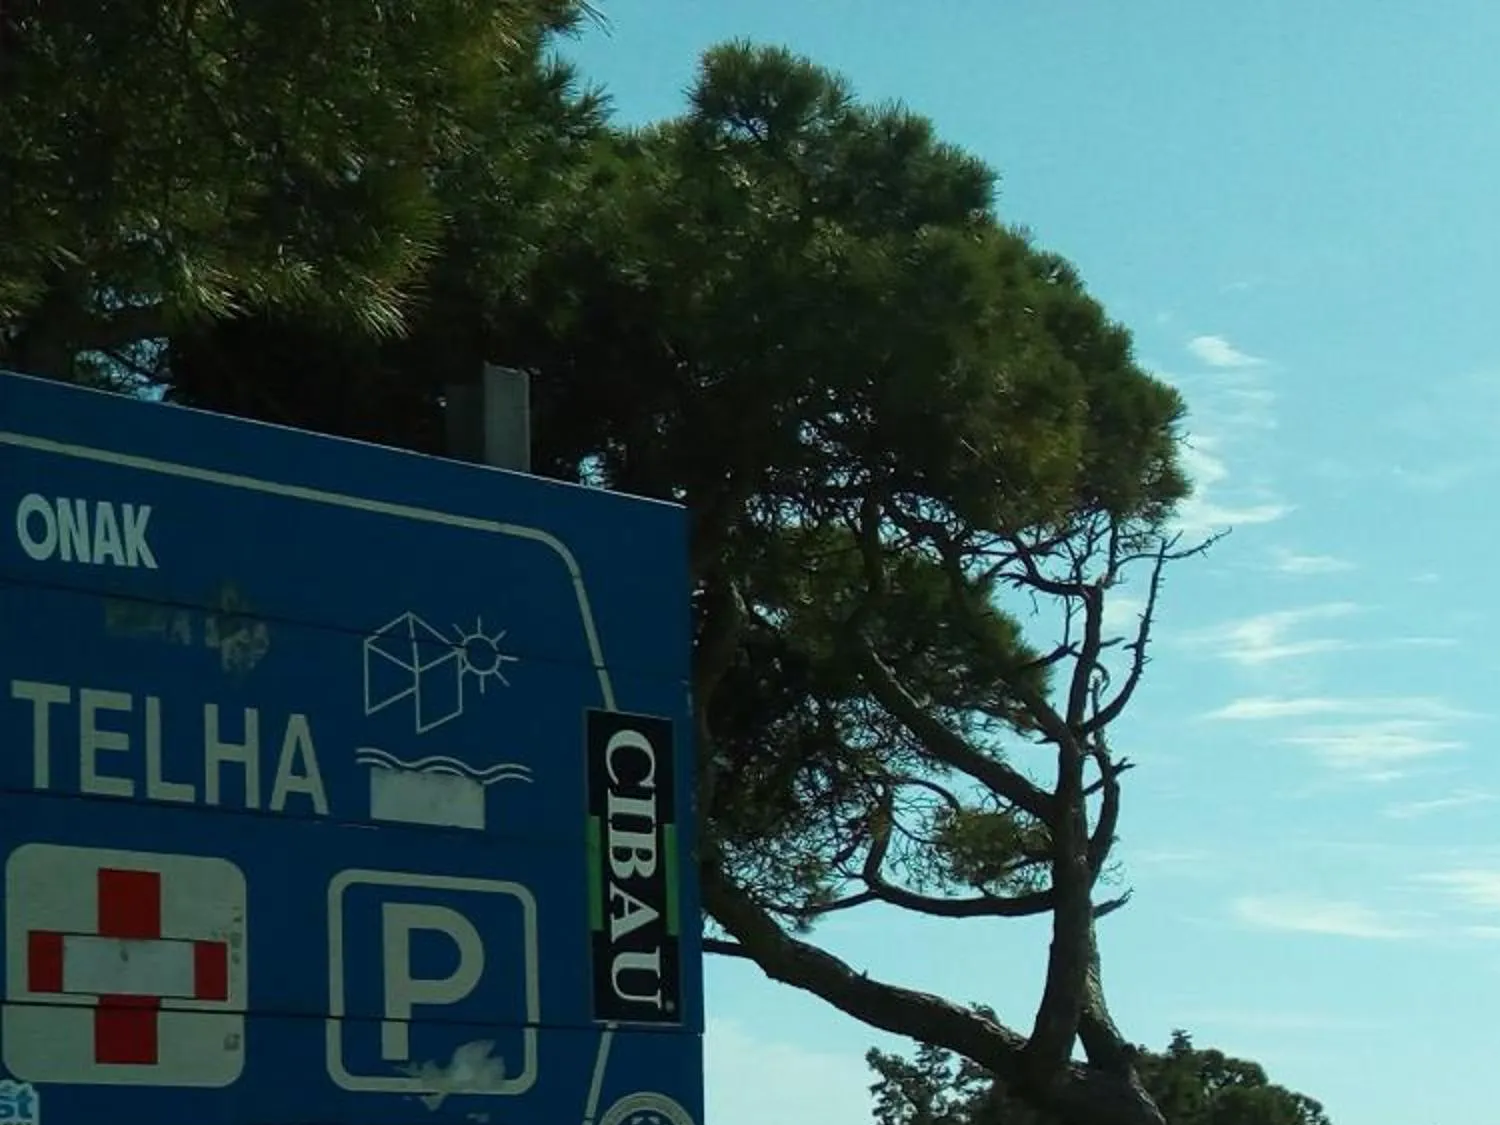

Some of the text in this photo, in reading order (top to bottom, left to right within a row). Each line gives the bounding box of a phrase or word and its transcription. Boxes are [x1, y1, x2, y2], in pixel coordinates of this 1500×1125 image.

[16, 493, 158, 569] ONAK
[11, 679, 329, 815] TELHA
[605, 729, 662, 1009] CIBAU
[381, 902, 485, 1061] P
